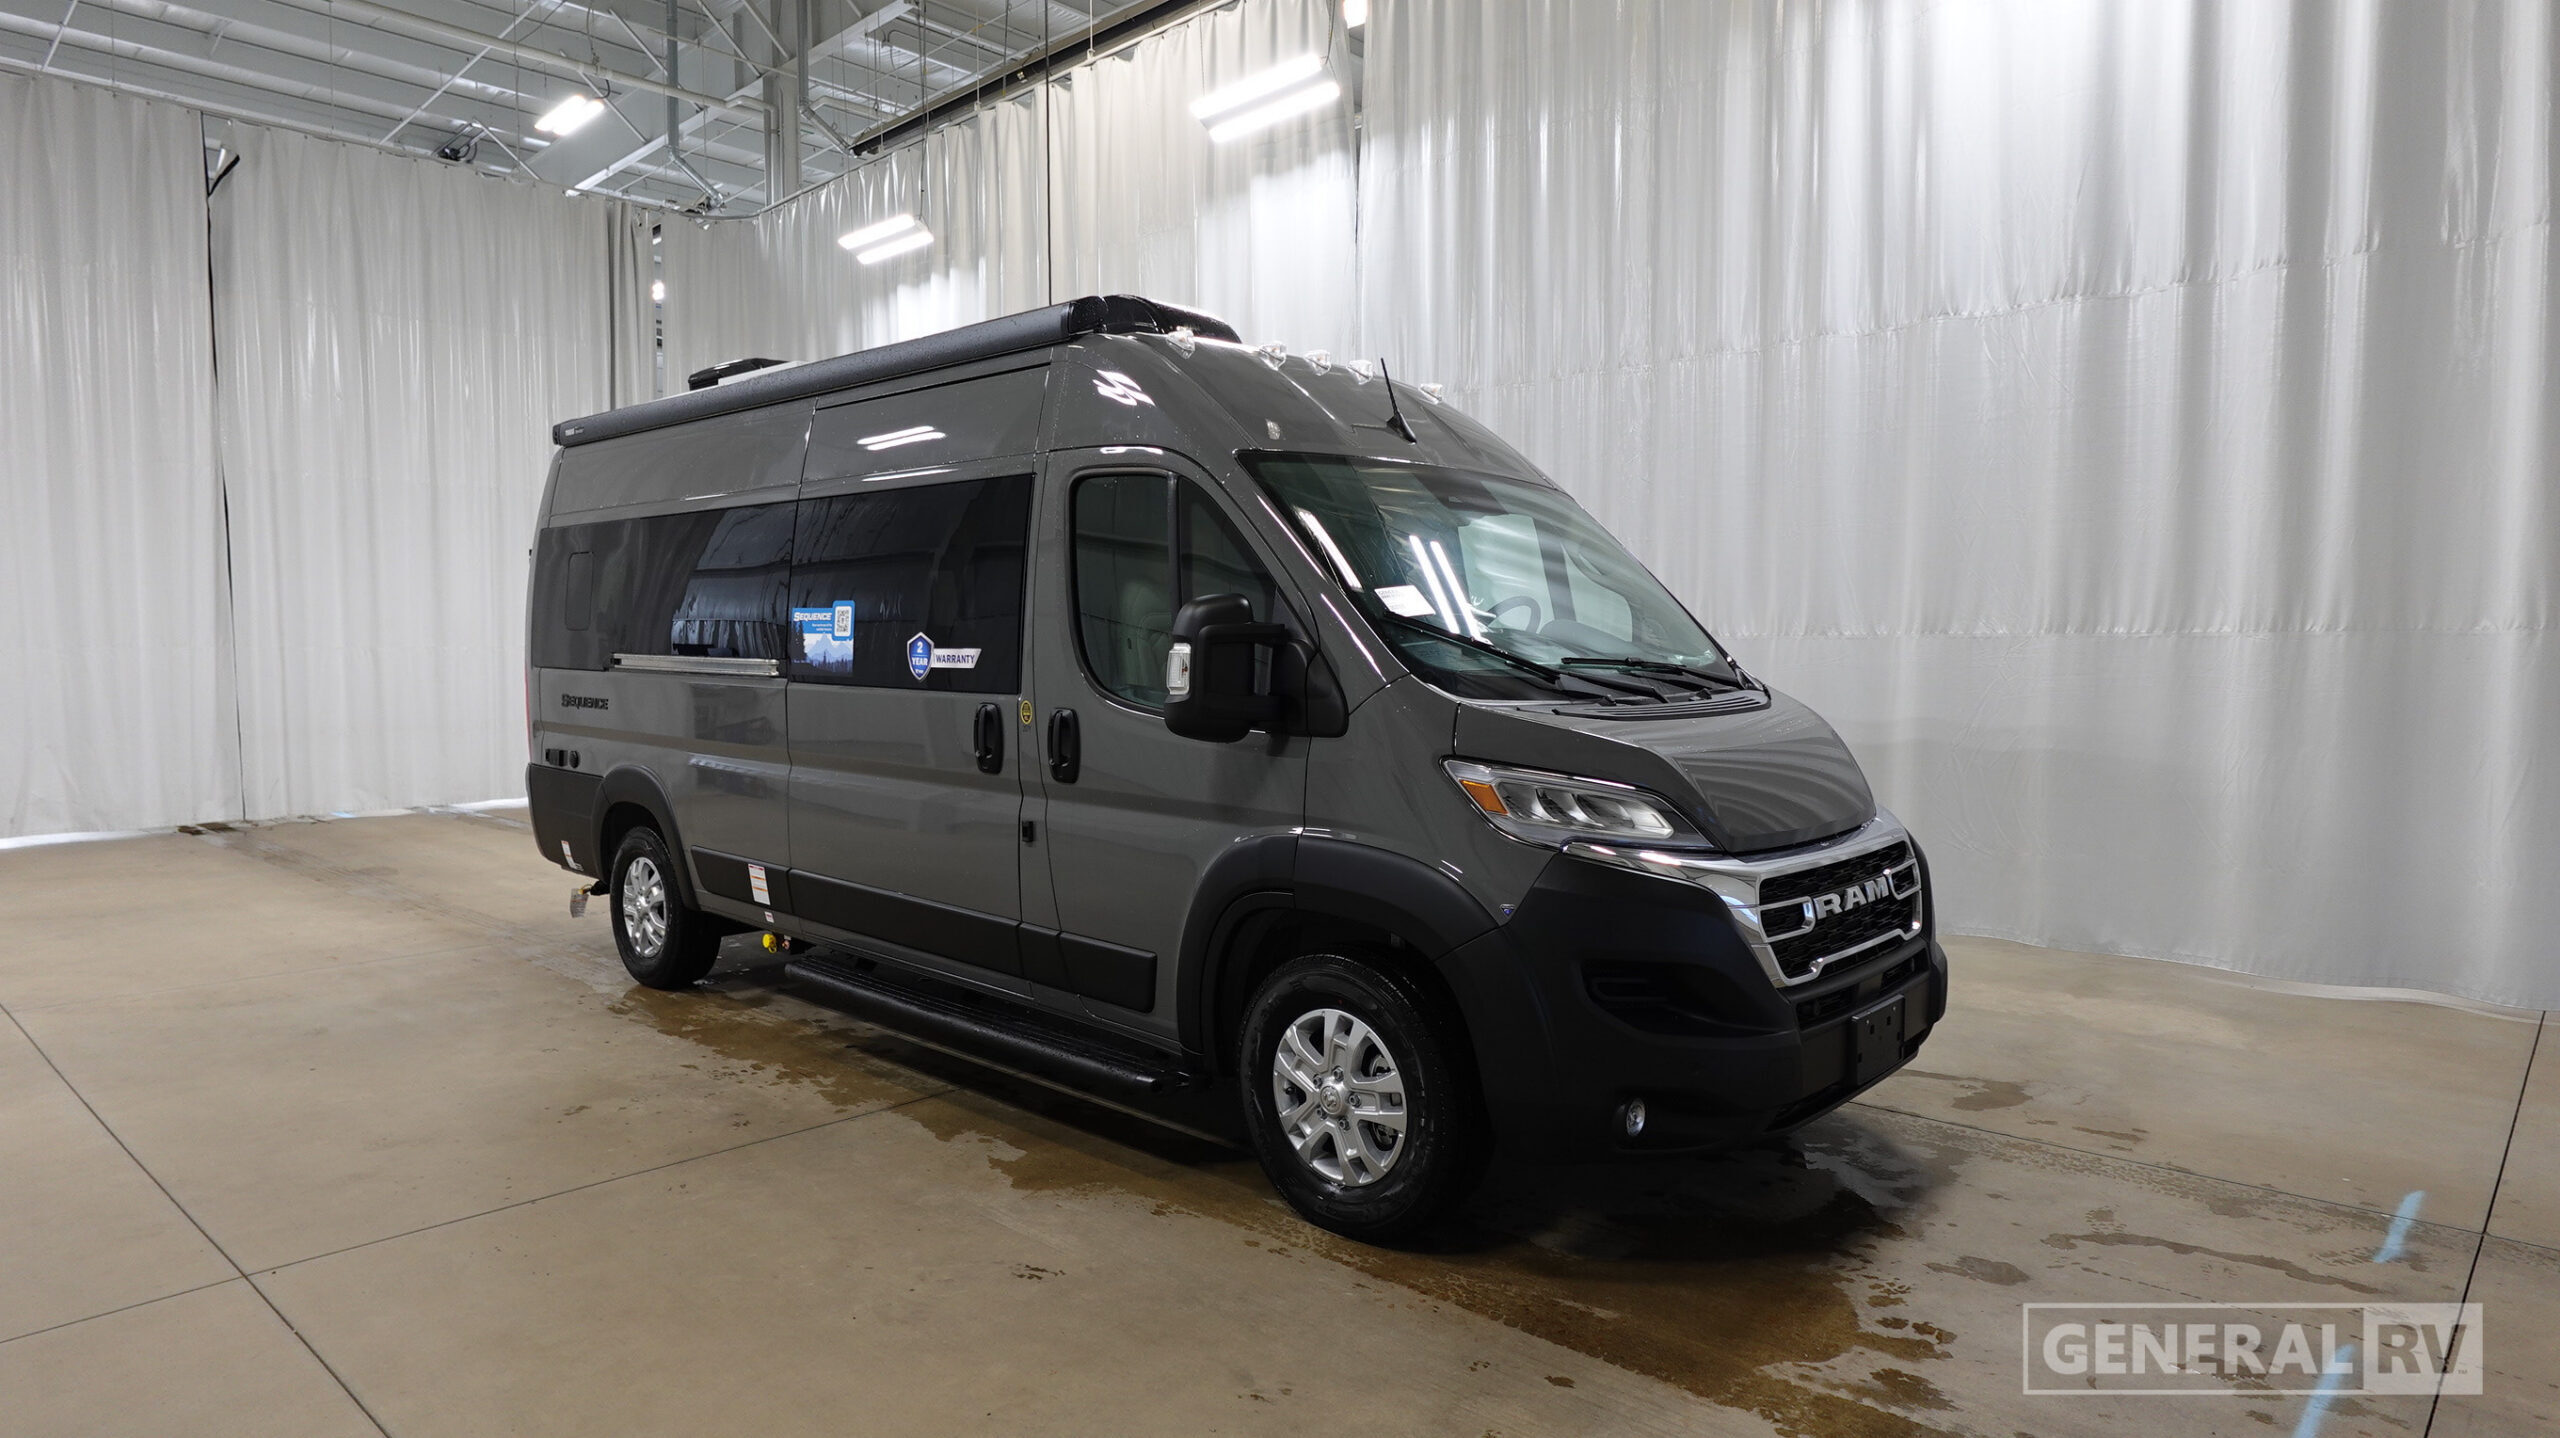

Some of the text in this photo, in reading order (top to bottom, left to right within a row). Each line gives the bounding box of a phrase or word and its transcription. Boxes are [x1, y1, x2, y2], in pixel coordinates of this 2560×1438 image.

[793, 612, 832, 622] SEQUENCE
[916, 641, 924, 653] 2
[911, 654, 975, 666] YEAR WARRANTY
[1813, 876, 1890, 920] RAM
